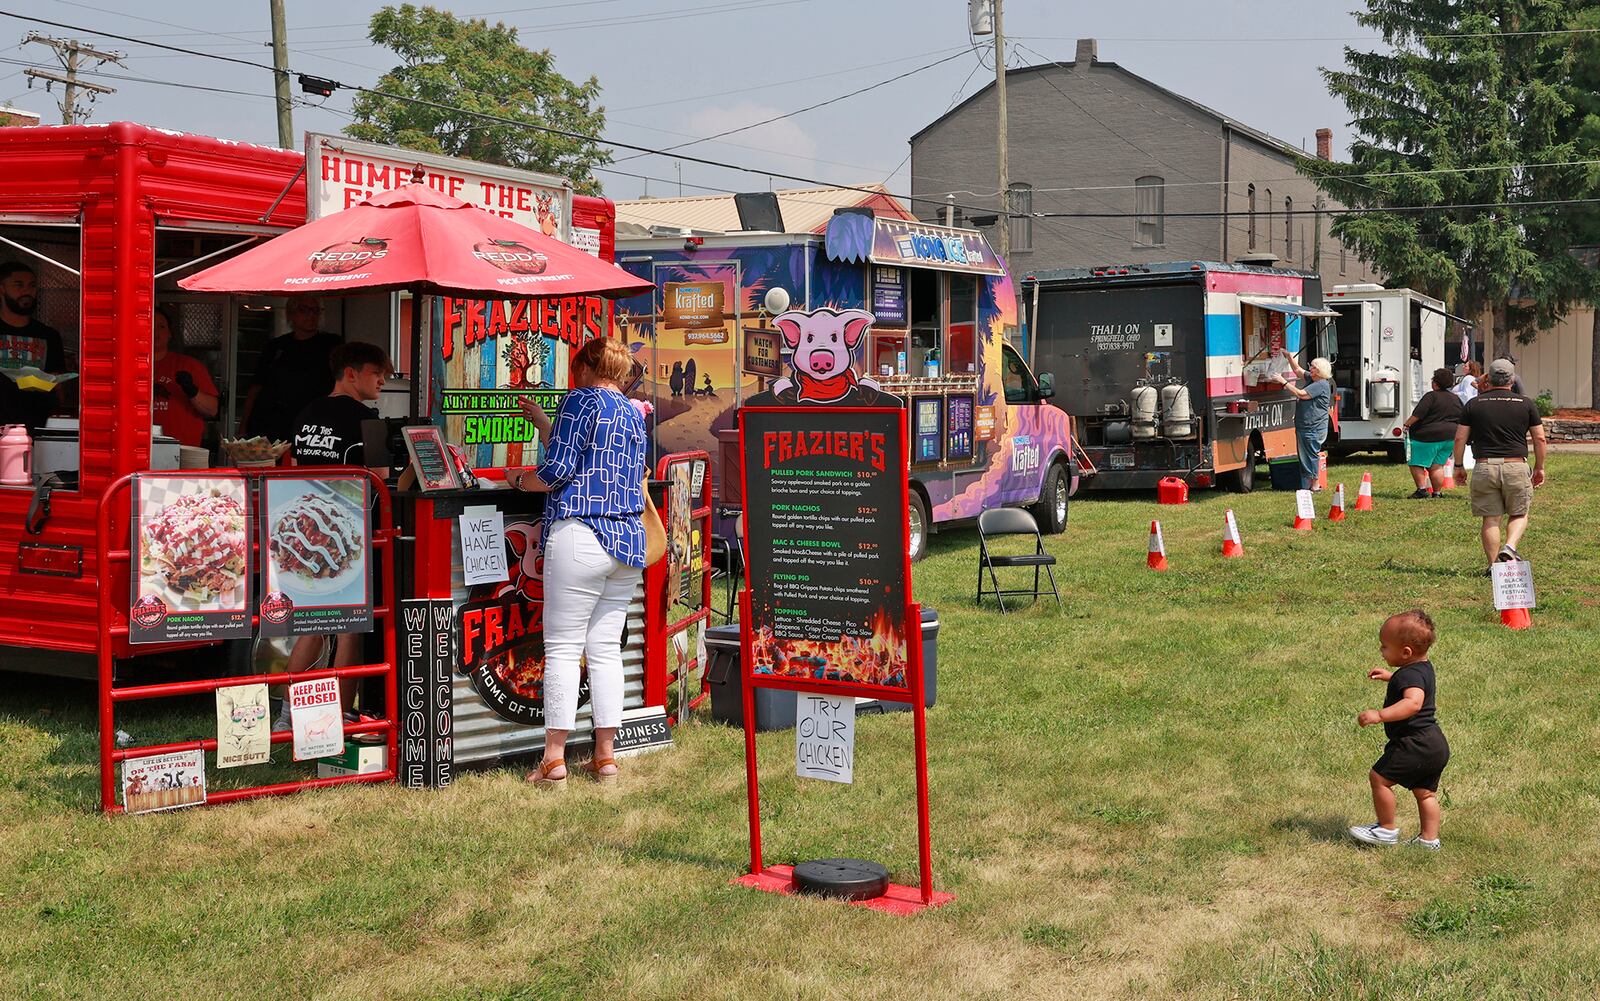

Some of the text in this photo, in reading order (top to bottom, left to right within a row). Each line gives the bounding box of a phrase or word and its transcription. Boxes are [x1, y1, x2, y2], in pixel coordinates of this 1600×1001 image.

[322, 155, 532, 212] HOME OF THE
[910, 232, 948, 264] KONA
[945, 236, 969, 265] ICE
[442, 296, 602, 360] FRAZIER'S
[1090, 325, 1114, 335] THAI
[1125, 324, 1140, 334] ON
[754, 337, 773, 348] WATCH
[758, 348, 768, 357] FOR
[748, 356, 778, 368] CUSTOMERS
[443, 396, 519, 409] AUTHENTIC
[1272, 404, 1283, 426] ON
[302, 424, 333, 435] PUT THIS
[465, 417, 534, 443] SMOKED
[295, 435, 342, 450] MEAT
[763, 429, 886, 472] FRAZIER'S
[469, 519, 492, 533] WE
[464, 534, 500, 550] HAVE
[466, 554, 506, 574] CHICKEN
[464, 603, 544, 665] FRAZ
[804, 624, 821, 633] Crispy
[821, 632, 840, 641] Cream
[293, 681, 335, 696] KEEP GATE
[479, 665, 544, 718] HOME OF TH
[294, 692, 336, 707] CLOSED
[404, 607, 426, 789] WELCOME
[434, 607, 452, 788] WELCOME
[808, 696, 841, 718] TRY
[614, 722, 666, 740] APPINESS
[800, 717, 846, 741] OUR
[223, 755, 242, 764] NICE
[799, 742, 850, 769] CHICKEN
[131, 767, 144, 775] ON
